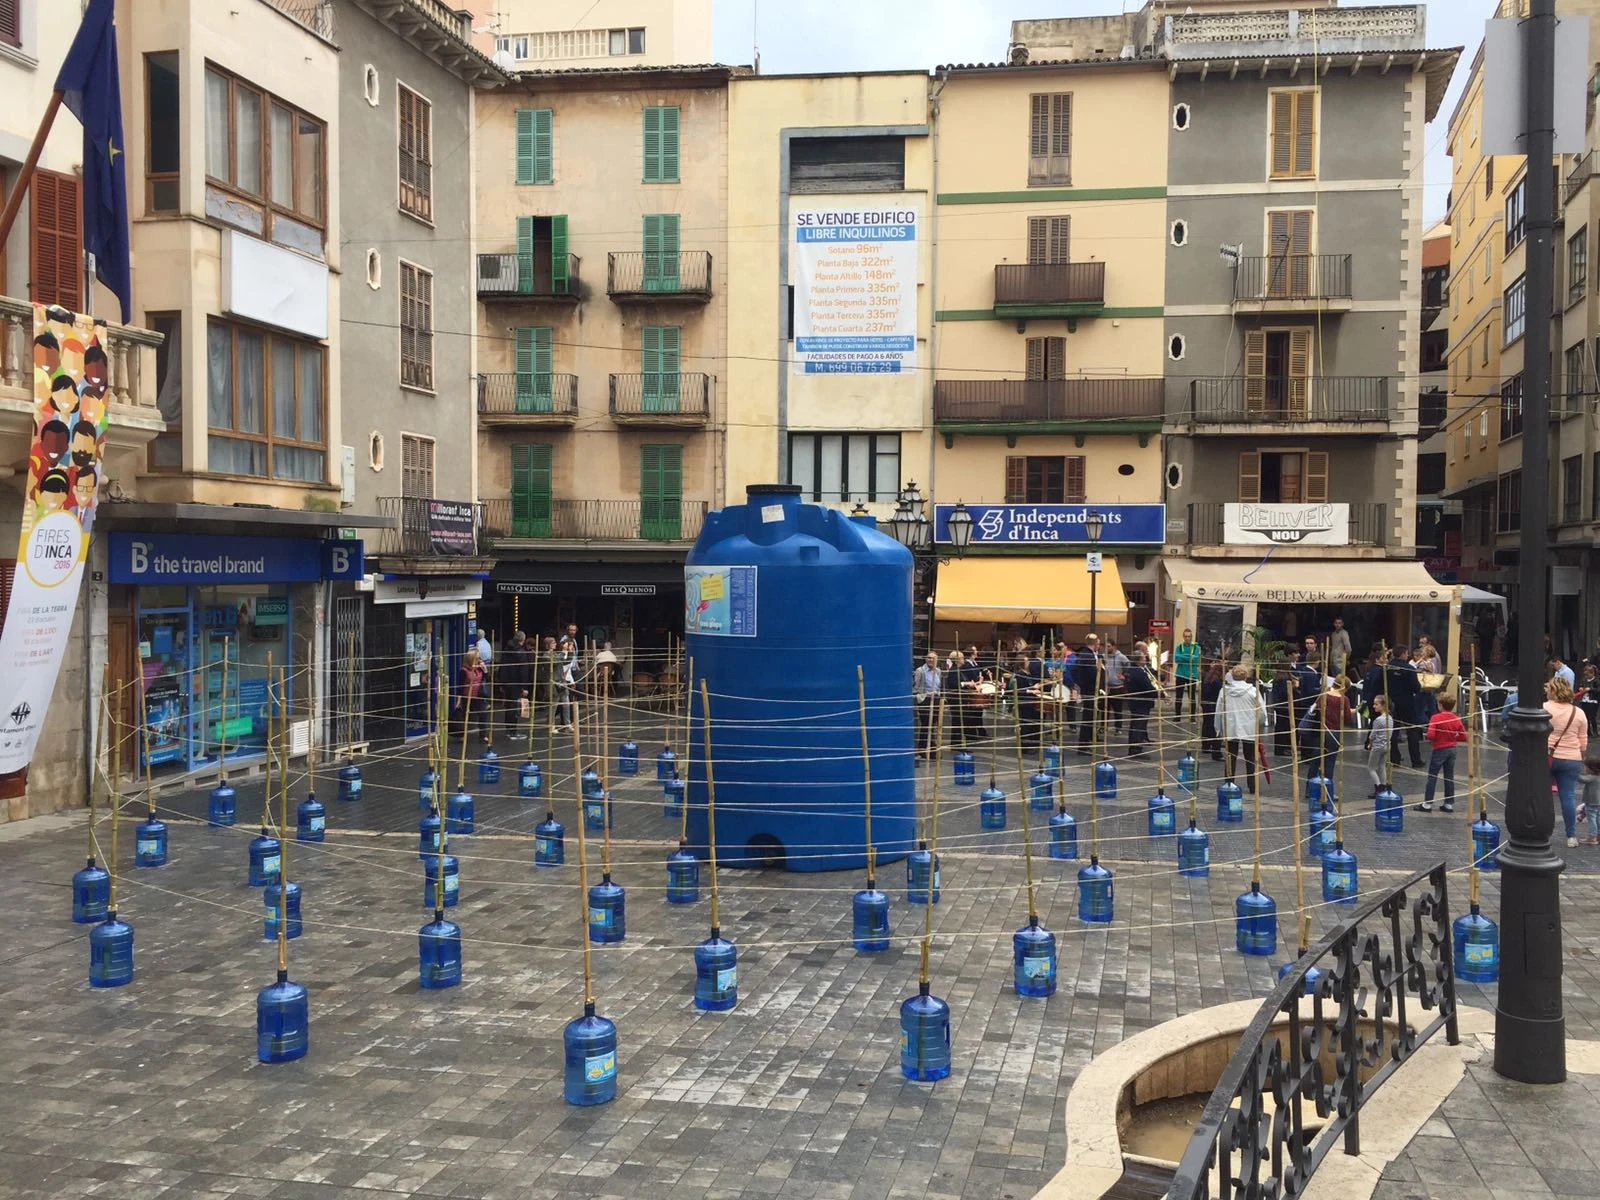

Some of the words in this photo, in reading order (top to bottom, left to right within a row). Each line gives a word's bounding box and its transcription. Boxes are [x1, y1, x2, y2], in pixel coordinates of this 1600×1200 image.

[797, 213, 813, 225] SE
[816, 212, 860, 225] VENDE
[864, 211, 915, 224] EDIFICO
[805, 228, 836, 239] LIBRE
[839, 227, 906, 239] INQUILINOS
[817, 259, 841, 267] Planta
[815, 272, 839, 280] Planta
[811, 286, 835, 294] Planta
[809, 299, 833, 307] Planta
[811, 312, 835, 320] Planta
[813, 325, 837, 333] Planta
[1009, 508, 1122, 527] Independnts
[36, 529, 71, 544] FIRES
[1008, 524, 1059, 540] d'Inca
[1272, 531, 1300, 540] NOU
[34, 544, 72, 559] D'INCA
[54, 560, 70, 569] 2016
[153, 555, 179, 574] the
[182, 556, 222, 574] travel
[225, 556, 264, 574] brand
[332, 547, 349, 574] B
